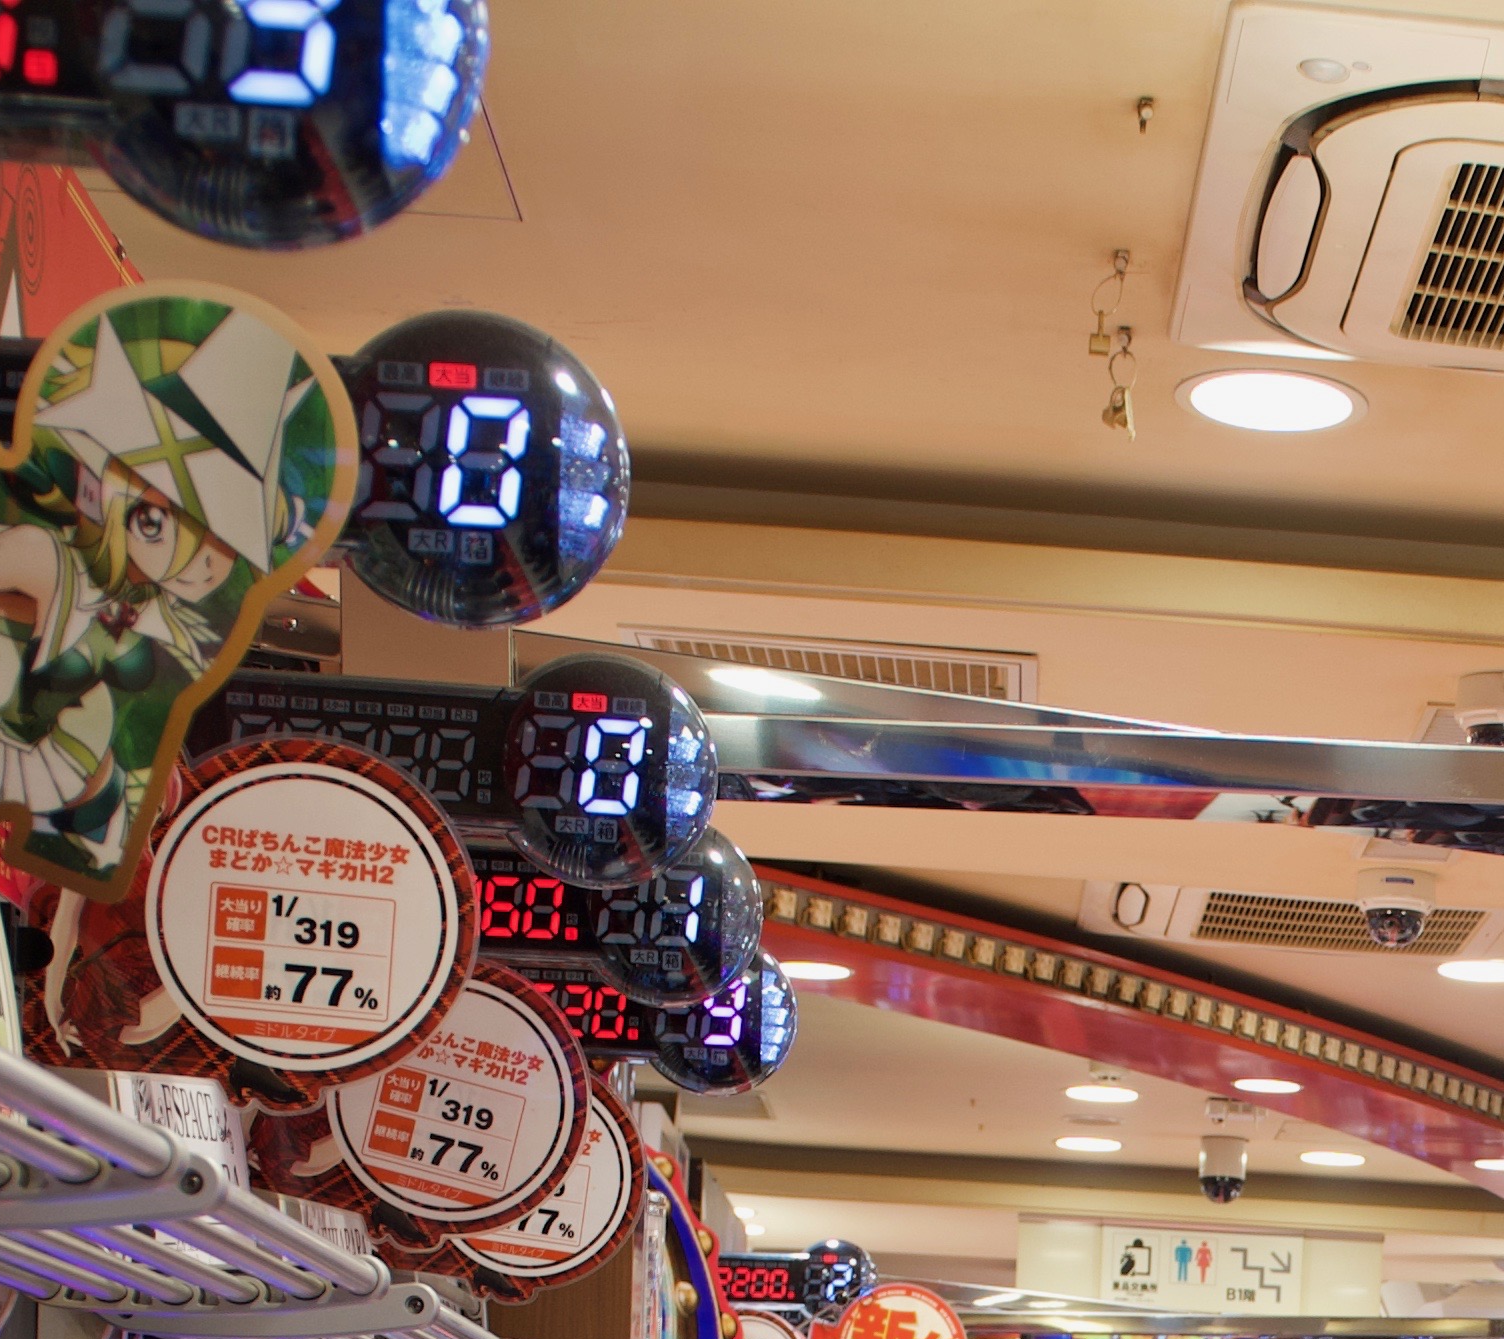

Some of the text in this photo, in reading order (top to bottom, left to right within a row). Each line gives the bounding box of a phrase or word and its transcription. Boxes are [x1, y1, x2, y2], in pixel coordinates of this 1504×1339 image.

[435, 367, 470, 385] 大当
[439, 395, 530, 529] 0
[413, 532, 490, 560] 大R 箱
[575, 696, 605, 710] 大当
[577, 717, 647, 816] 0
[558, 817, 616, 841] 大R 箱
[220, 897, 262, 915] 大当り
[685, 875, 704, 943] 1
[225, 916, 255, 932] 確率
[633, 951, 680, 969] 大R 箱
[215, 963, 261, 981] 継続率
[253, 1021, 336, 1041] ミドルタイプ
[386, 1073, 420, 1092] 大当り
[160, 1083, 218, 1142] ESPACE
[1226, 1288, 1256, 1302] B1階
